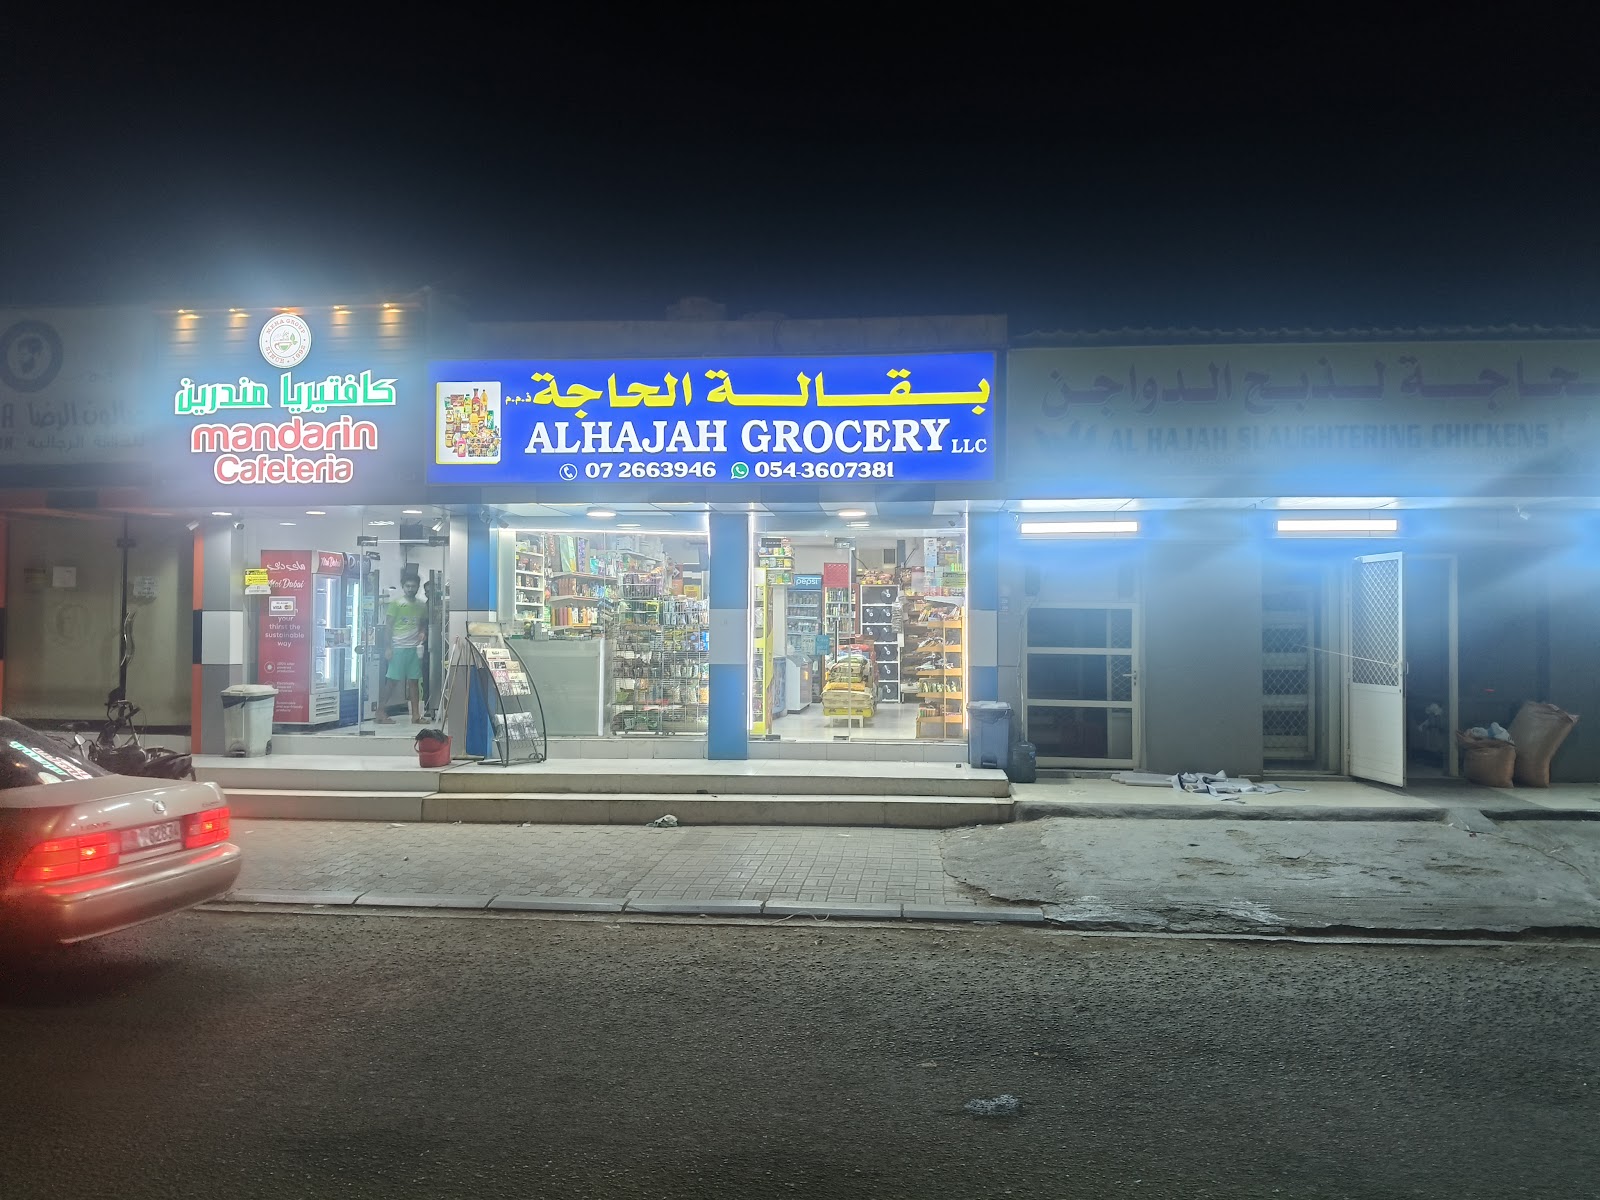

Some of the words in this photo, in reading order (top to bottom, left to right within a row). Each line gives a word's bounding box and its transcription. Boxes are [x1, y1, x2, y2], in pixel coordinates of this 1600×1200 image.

[177, 378, 270, 414] مندرين
[282, 372, 396, 413] كافتيريا
[531, 371, 693, 419] الحاجة
[704, 368, 990, 415] بقالة
[1041, 359, 1233, 419] الدواجن
[192, 416, 377, 451] mandarin
[524, 419, 728, 454] ALHAJAH
[741, 418, 951, 454] GROCERY
[951, 438, 988, 454] LLC
[1147, 427, 1229, 455] HAJAH
[1431, 422, 1552, 449] CHICKENS
[215, 455, 353, 483] Cafeteria
[585, 462, 614, 479] 07
[618, 461, 717, 479] 2663946
[795, 578, 818, 586] pepsi
[264, 631, 305, 639] sustainable
[269, 622, 289, 630] thirst
[289, 622, 301, 630] the
